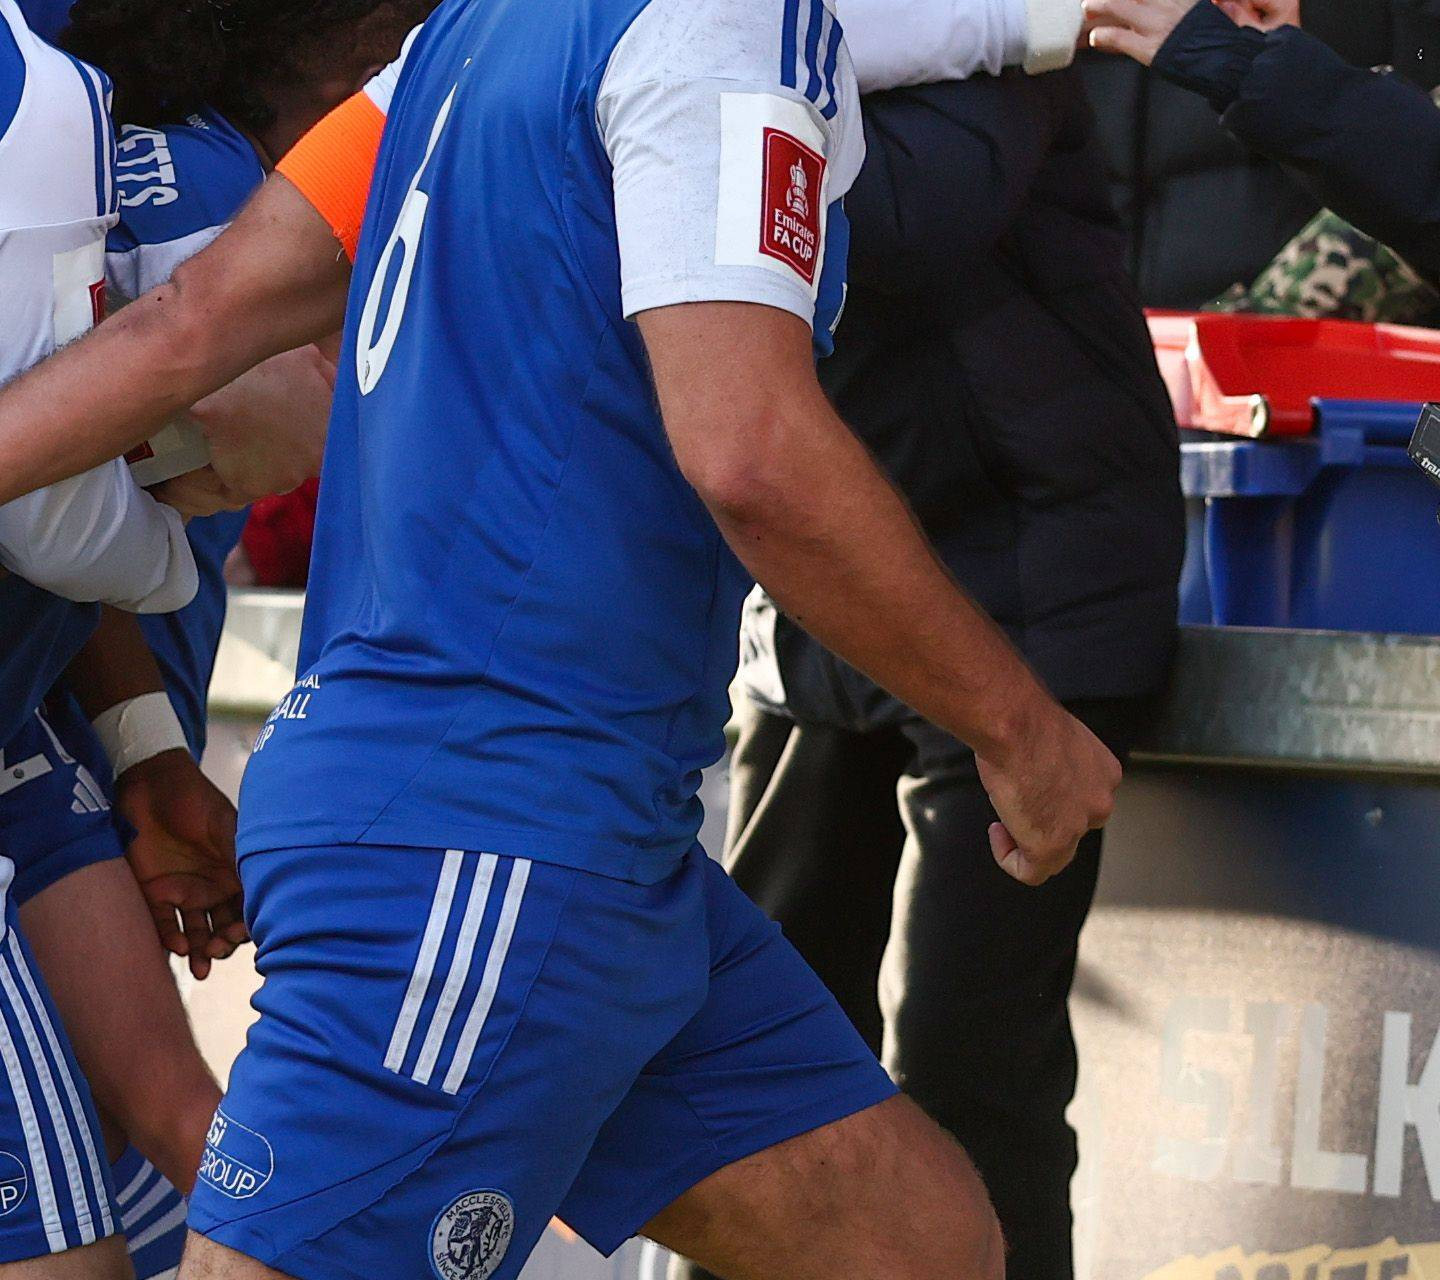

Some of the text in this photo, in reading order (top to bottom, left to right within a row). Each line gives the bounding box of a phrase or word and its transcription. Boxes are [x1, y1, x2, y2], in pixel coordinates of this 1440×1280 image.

[773, 225, 813, 262] FA CUP
[774, 207, 816, 246] Emirates
[445, 1194, 512, 1240] MACCLESFIELD FC
